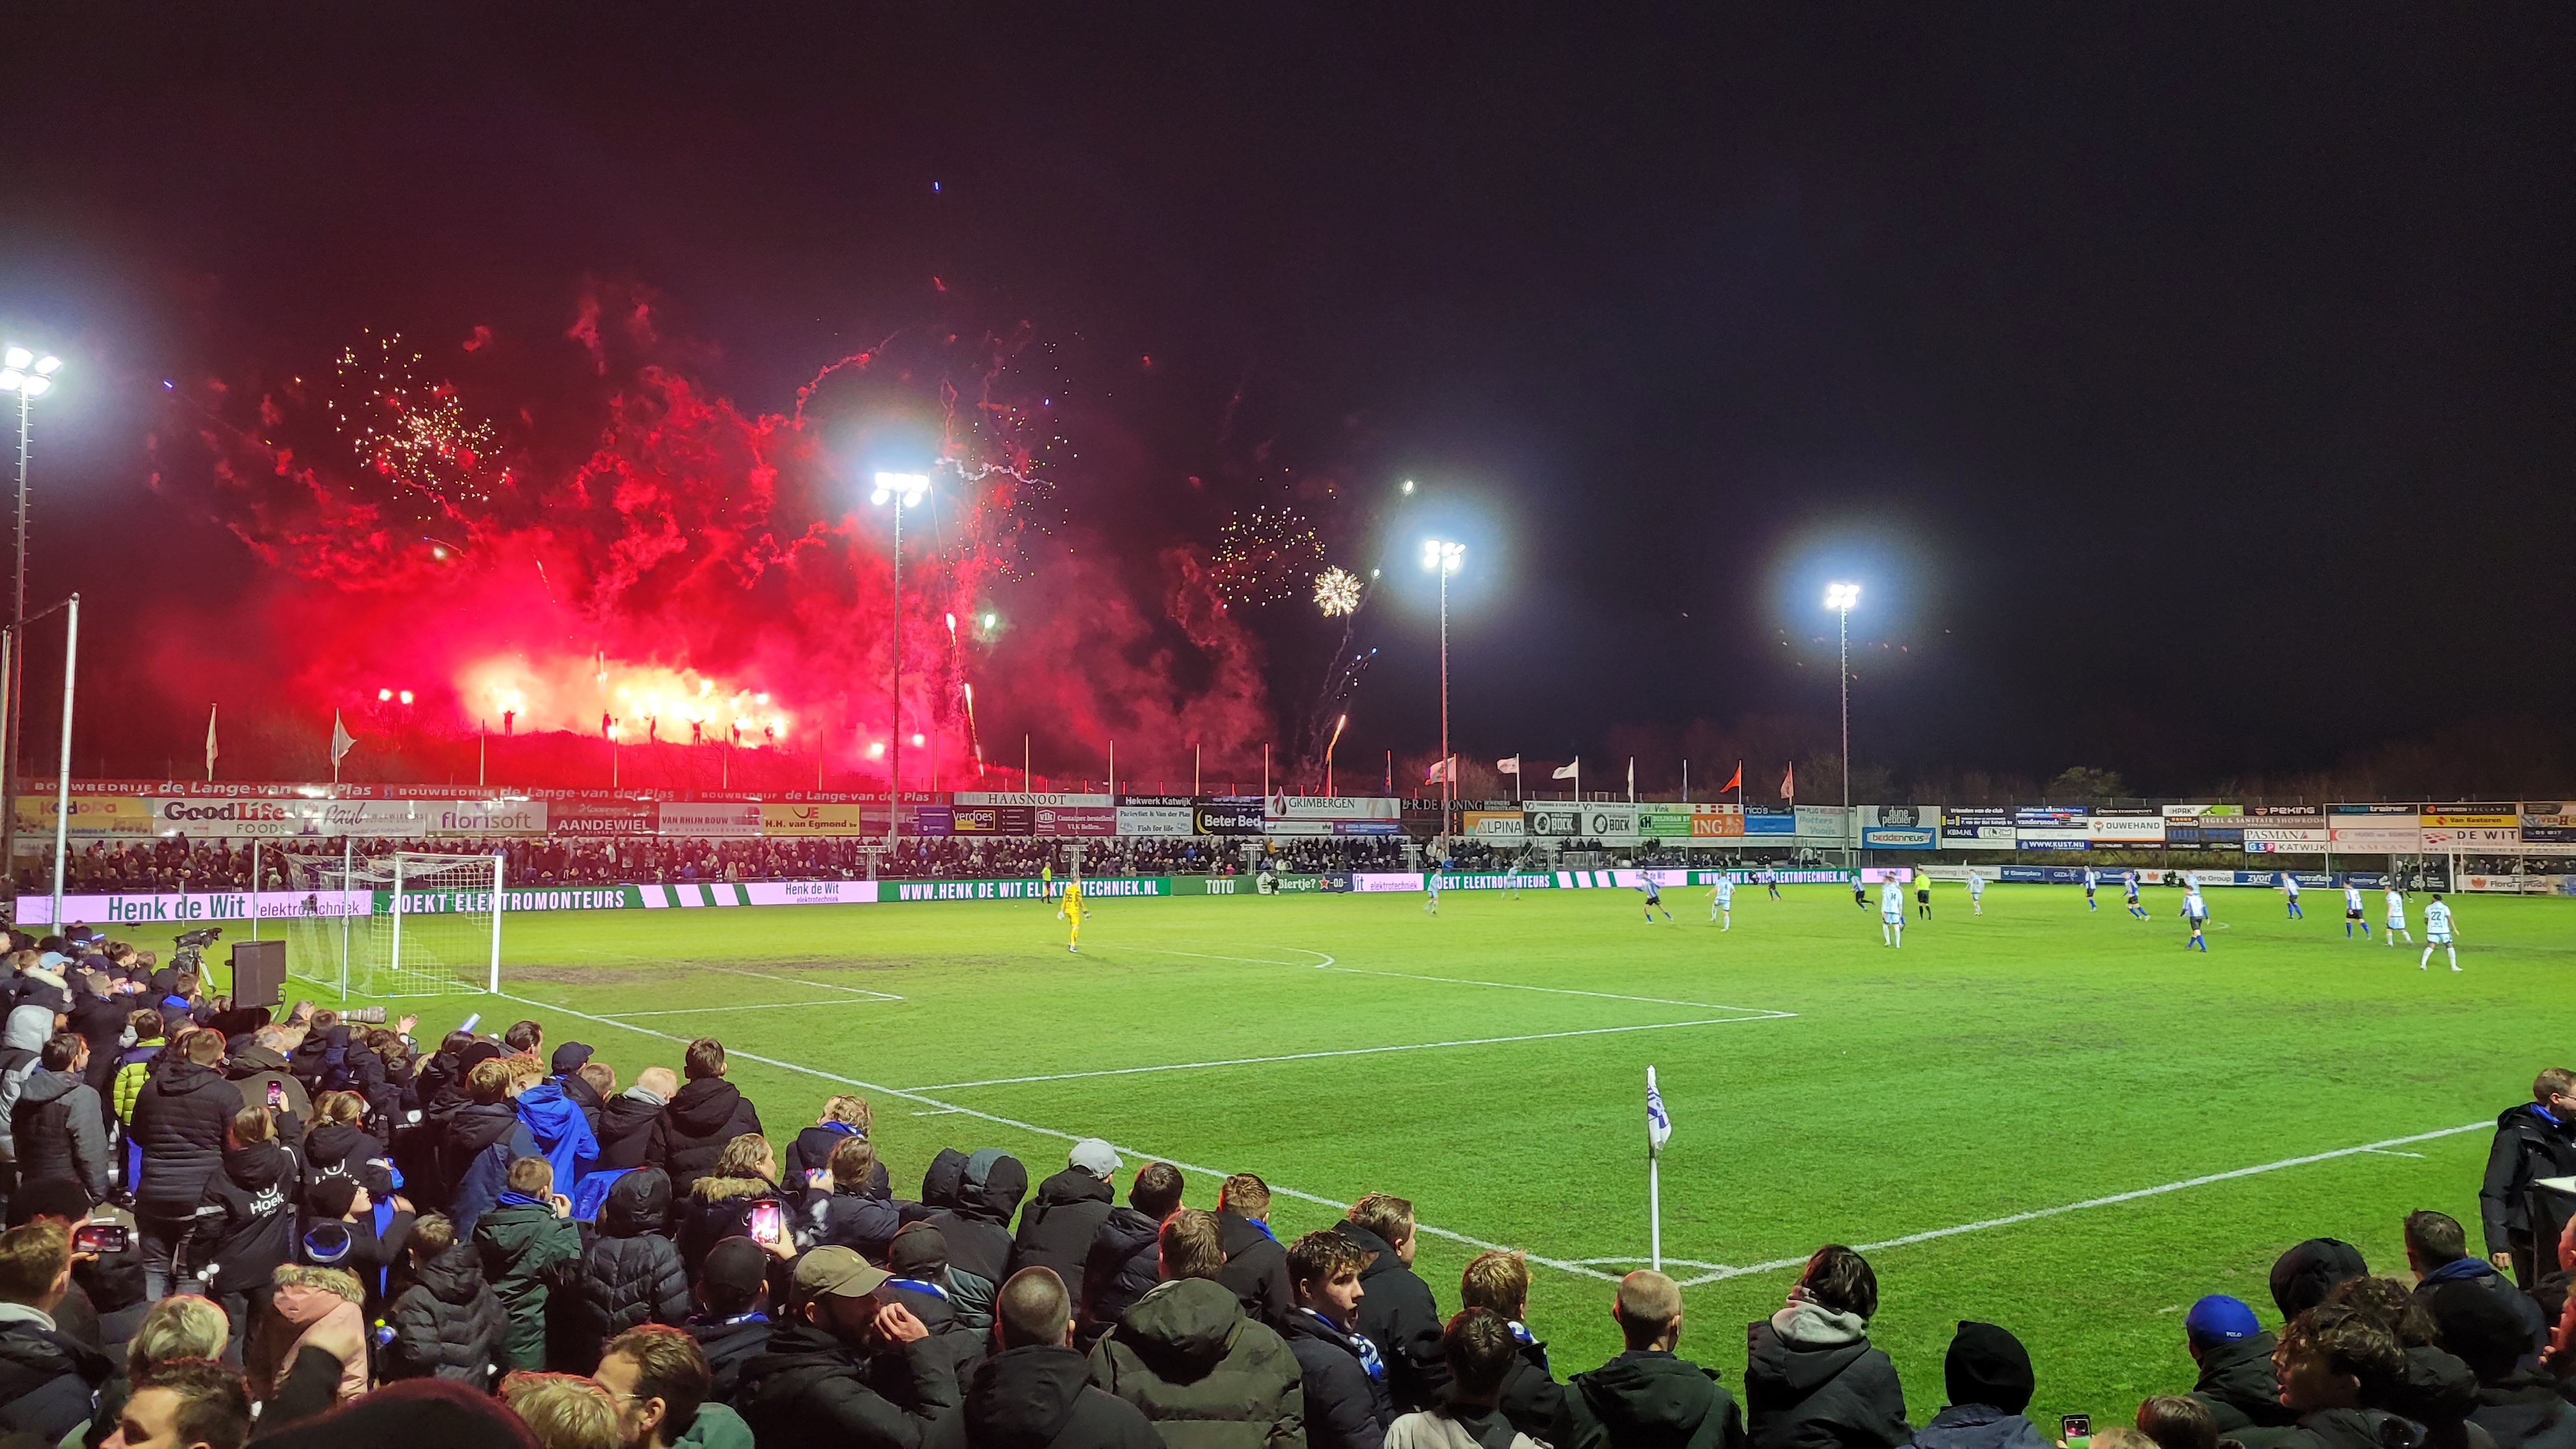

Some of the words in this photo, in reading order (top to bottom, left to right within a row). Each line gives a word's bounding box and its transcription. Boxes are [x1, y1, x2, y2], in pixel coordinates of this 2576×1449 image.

[34, 783, 152, 792] BOWBEDRIJF
[158, 780, 184, 793] de
[191, 781, 291, 797] Lange-van
[337, 784, 372, 796] Plas
[399, 788, 495, 797] BOUWBEDRIJF
[502, 786, 521, 797] de
[527, 786, 610, 801] Lange-van
[613, 788, 640, 799] der
[645, 788, 675, 799] Plas
[702, 791, 778, 799] BOUWBEDRIJF
[785, 790, 802, 800] de
[806, 790, 874, 802] Lange-van
[904, 792, 930, 802] Plas
[988, 793, 1066, 805] HAASNOOT
[1125, 796, 1160, 805] Hekwerk
[1289, 797, 1355, 808] GRIMBERGEN
[1423, 799, 1438, 810] DE
[1655, 804, 1669, 813] Vink
[164, 801, 287, 821] GoodLife
[1889, 806, 1909, 816] dune
[442, 811, 532, 829] florisoft
[558, 819, 650, 831] AANDEWIEL
[662, 816, 678, 824] VAN
[680, 816, 703, 825] RHIJN
[705, 816, 729, 825] BOUW
[765, 820, 786, 828] H.H.
[808, 820, 847, 829] Egmond
[1204, 815, 1237, 827] Beter
[1238, 815, 1262, 827] Bed
[1551, 818, 1574, 830] BOCK
[1609, 819, 1630, 831] BOCK
[1798, 815, 1834, 825] Potters
[236, 824, 286, 834] FOODS
[1477, 820, 1522, 834] ALPINA
[1693, 819, 1723, 834] ING
[1810, 827, 1836, 835] Vooijs
[1873, 833, 1924, 842] beddenreus
[2457, 831, 2478, 839] DE
[2484, 831, 2517, 840] WIT
[2249, 842, 2274, 851] GSP
[1278, 878, 1316, 890] Biertje?
[1438, 876, 1461, 890] OEKT
[1463, 874, 1551, 889] ELEKTRONTEURS
[1698, 871, 1742, 885] WWWENK
[2247, 875, 2272, 884] zyon
[786, 883, 809, 895] Henk
[811, 882, 823, 894] de
[824, 882, 839, 894] Wit
[899, 883, 973, 900] WWW.HENK
[978, 882, 994, 898] DE
[999, 882, 1022, 898] WIT
[1027, 880, 1159, 897] ELKTRTECHNIEK.NL
[1205, 879, 1236, 894] TOTO
[1370, 879, 1418, 890] elektrotechniek
[797, 895, 839, 903] elektrotechniek
[108, 896, 168, 921] Henk
[174, 895, 202, 919] de
[210, 894, 246, 918] Wit
[259, 900, 360, 917] elektrochniek
[2431, 911, 2442, 921] 22
[250, 1192, 285, 1215] Hoek
